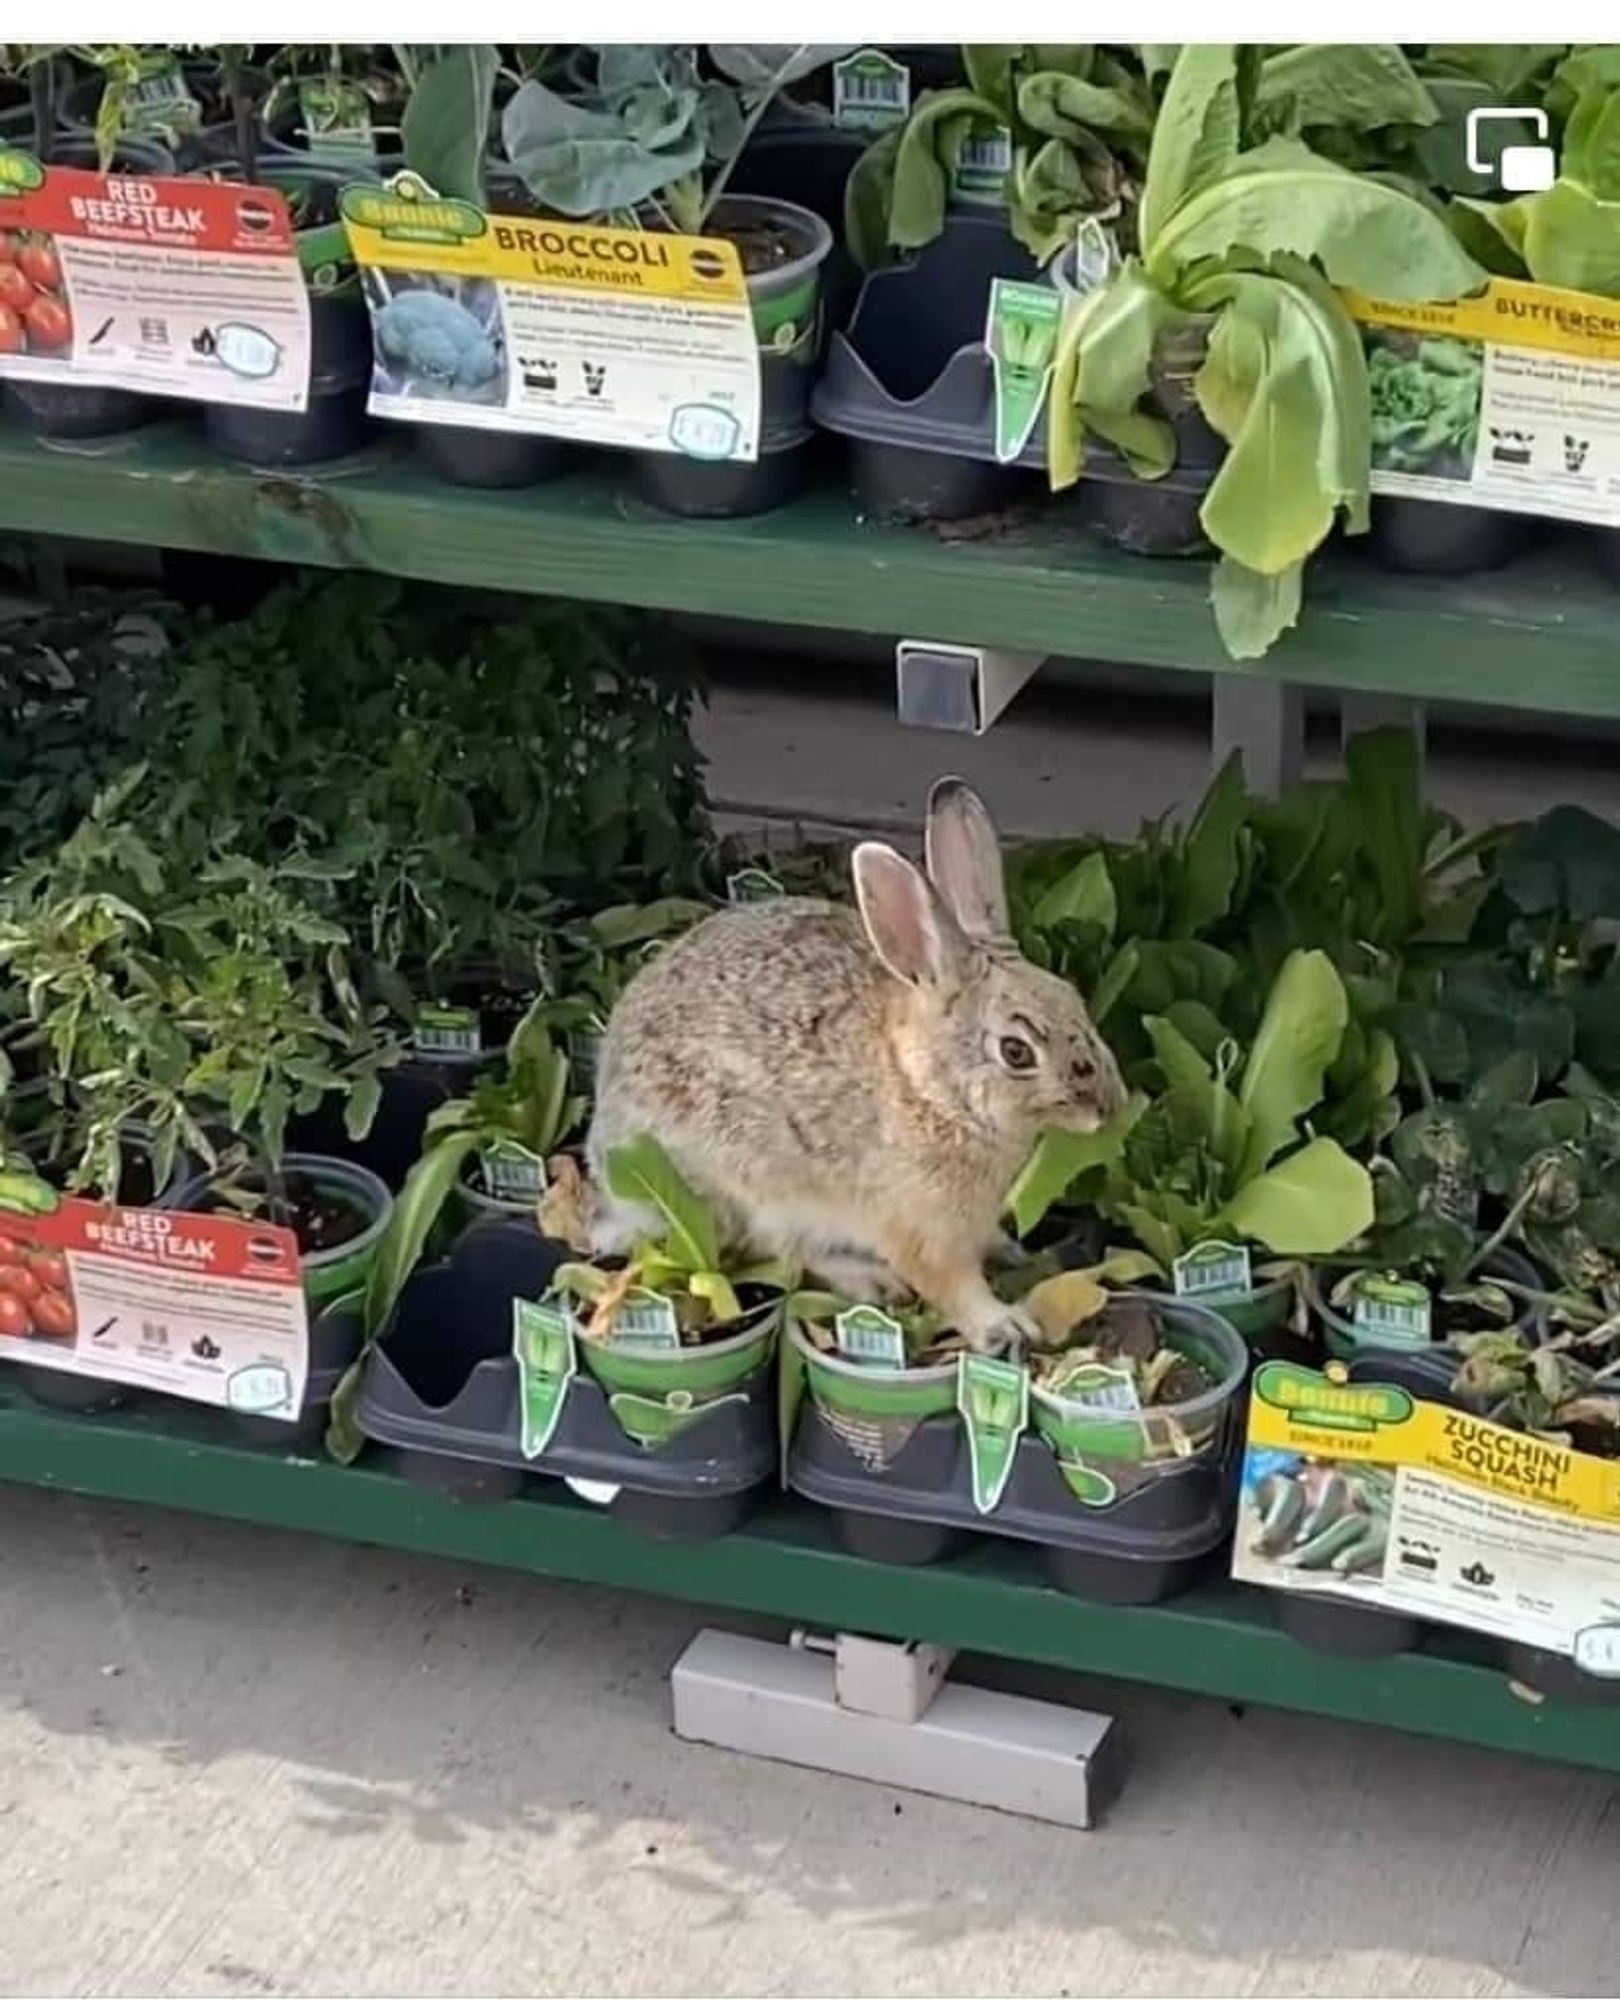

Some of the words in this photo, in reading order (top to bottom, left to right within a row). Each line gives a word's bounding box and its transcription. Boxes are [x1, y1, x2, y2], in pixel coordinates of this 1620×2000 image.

[106, 180, 158, 205] RED
[69, 196, 206, 234] BEEFSTEAK
[494, 227, 669, 268] BROCCOLI
[534, 257, 643, 287] Lieutenant
[85, 1220, 216, 1261] BEEFSTEAK
[123, 1212, 173, 1235] RED
[1443, 1414, 1571, 1473] ZUCCHINI
[1450, 1439, 1558, 1492] SQUASH
